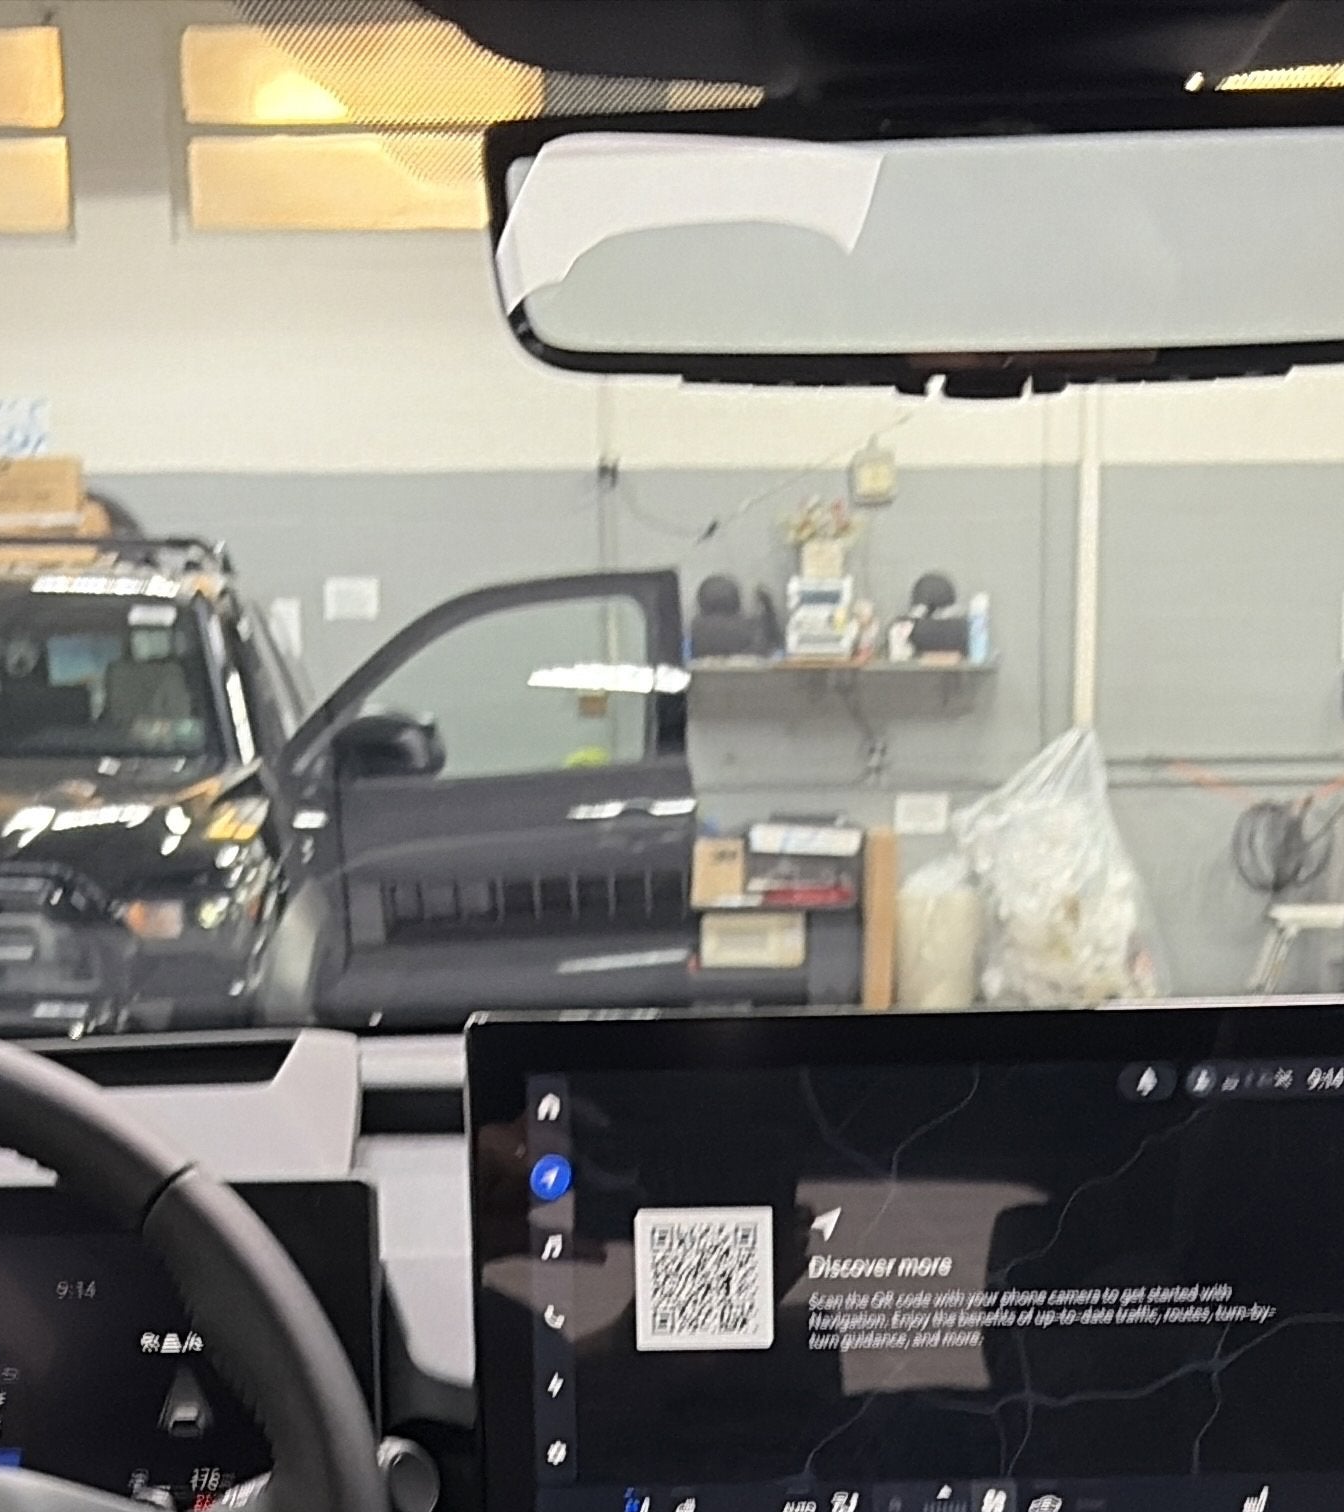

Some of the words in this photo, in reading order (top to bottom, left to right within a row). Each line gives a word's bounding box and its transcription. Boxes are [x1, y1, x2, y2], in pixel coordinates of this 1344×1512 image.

[808, 1254, 896, 1278] Discover
[897, 1256, 952, 1278] more
[809, 1291, 844, 1311] Scan
[844, 1291, 869, 1310] the
[870, 1290, 894, 1309] QR
[895, 1290, 932, 1309] code
[933, 1288, 966, 1308] with
[966, 1290, 999, 1310] your
[999, 1287, 1047, 1309] phone
[1047, 1287, 1101, 1306] camera
[1101, 1287, 1119, 1305] to
[1120, 1286, 1146, 1306] get
[1147, 1283, 1199, 1303] started
[1200, 1283, 1233, 1302] with
[890, 1310, 932, 1331] Enjoy
[932, 1310, 958, 1328] the
[958, 1308, 1016, 1328] benefits
[1017, 1307, 1034, 1327] of
[1163, 1304, 1214, 1325] routes,
[808, 1332, 840, 1350] turn
[840, 1331, 911, 1353] guidance,
[912, 1330, 941, 1348] and
